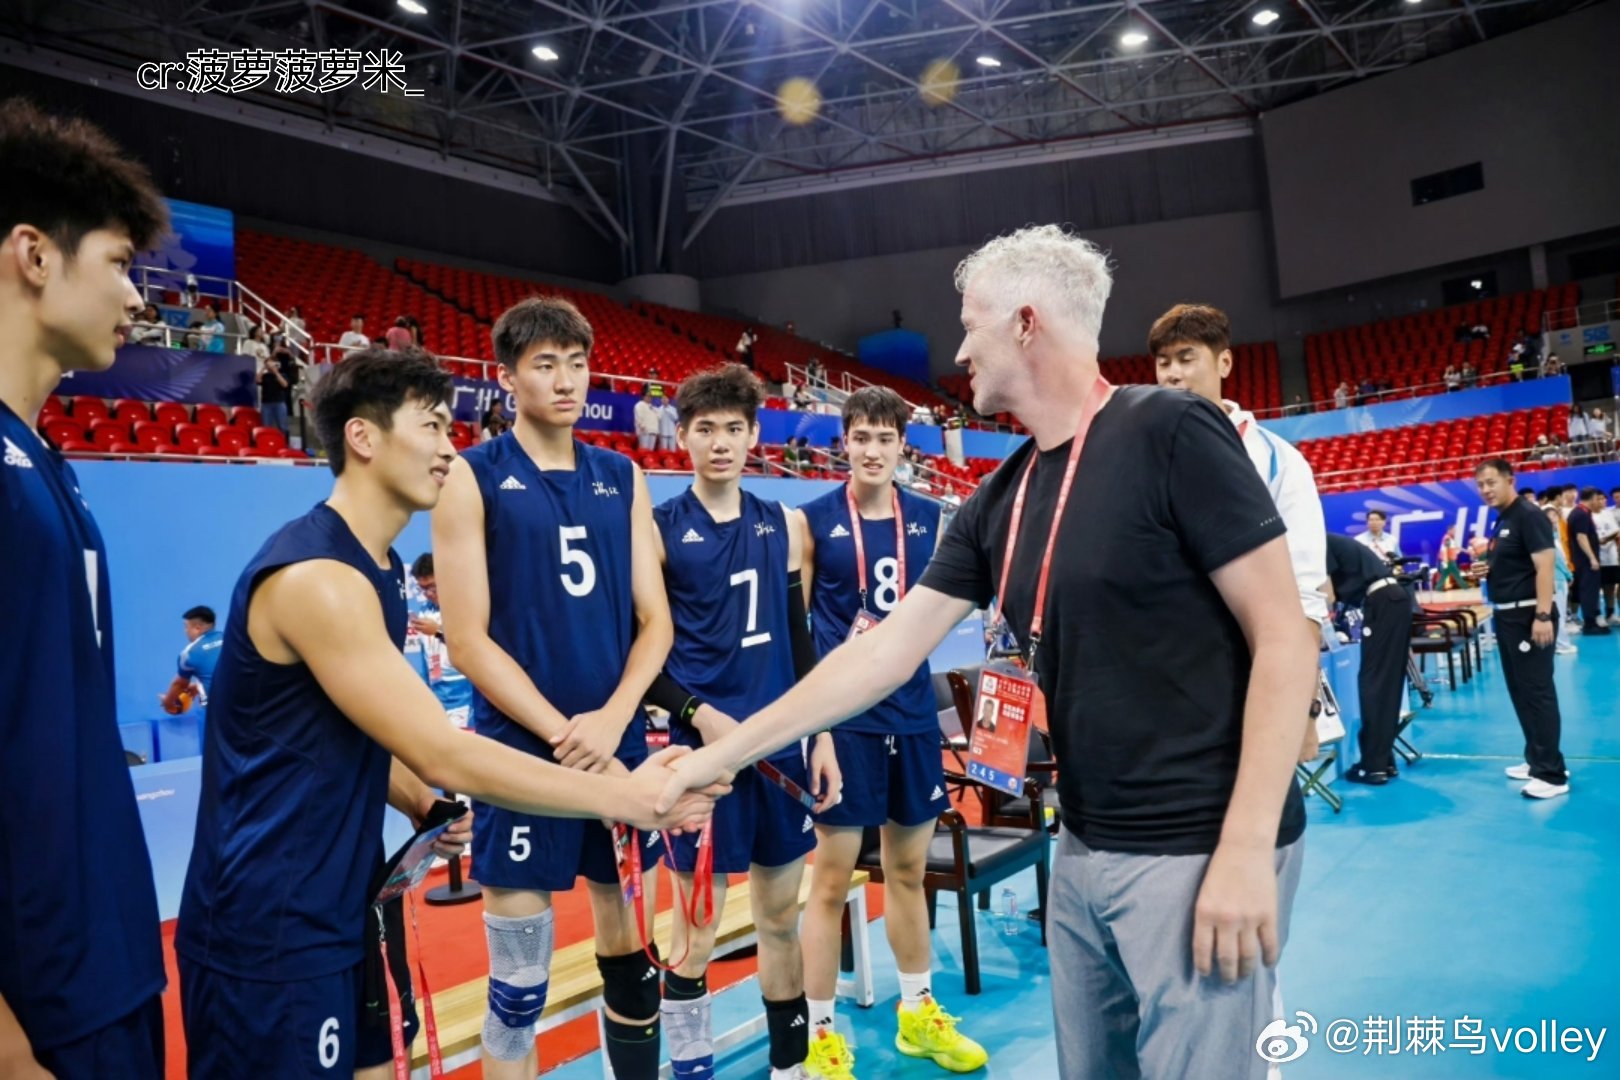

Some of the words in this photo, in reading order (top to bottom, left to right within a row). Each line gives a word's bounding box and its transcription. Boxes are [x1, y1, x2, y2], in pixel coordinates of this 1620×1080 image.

[559, 525, 596, 597] 5
[874, 556, 898, 612] 8
[730, 568, 758, 633] 7
[508, 826, 531, 862] 5
[318, 1016, 340, 1069] 6
